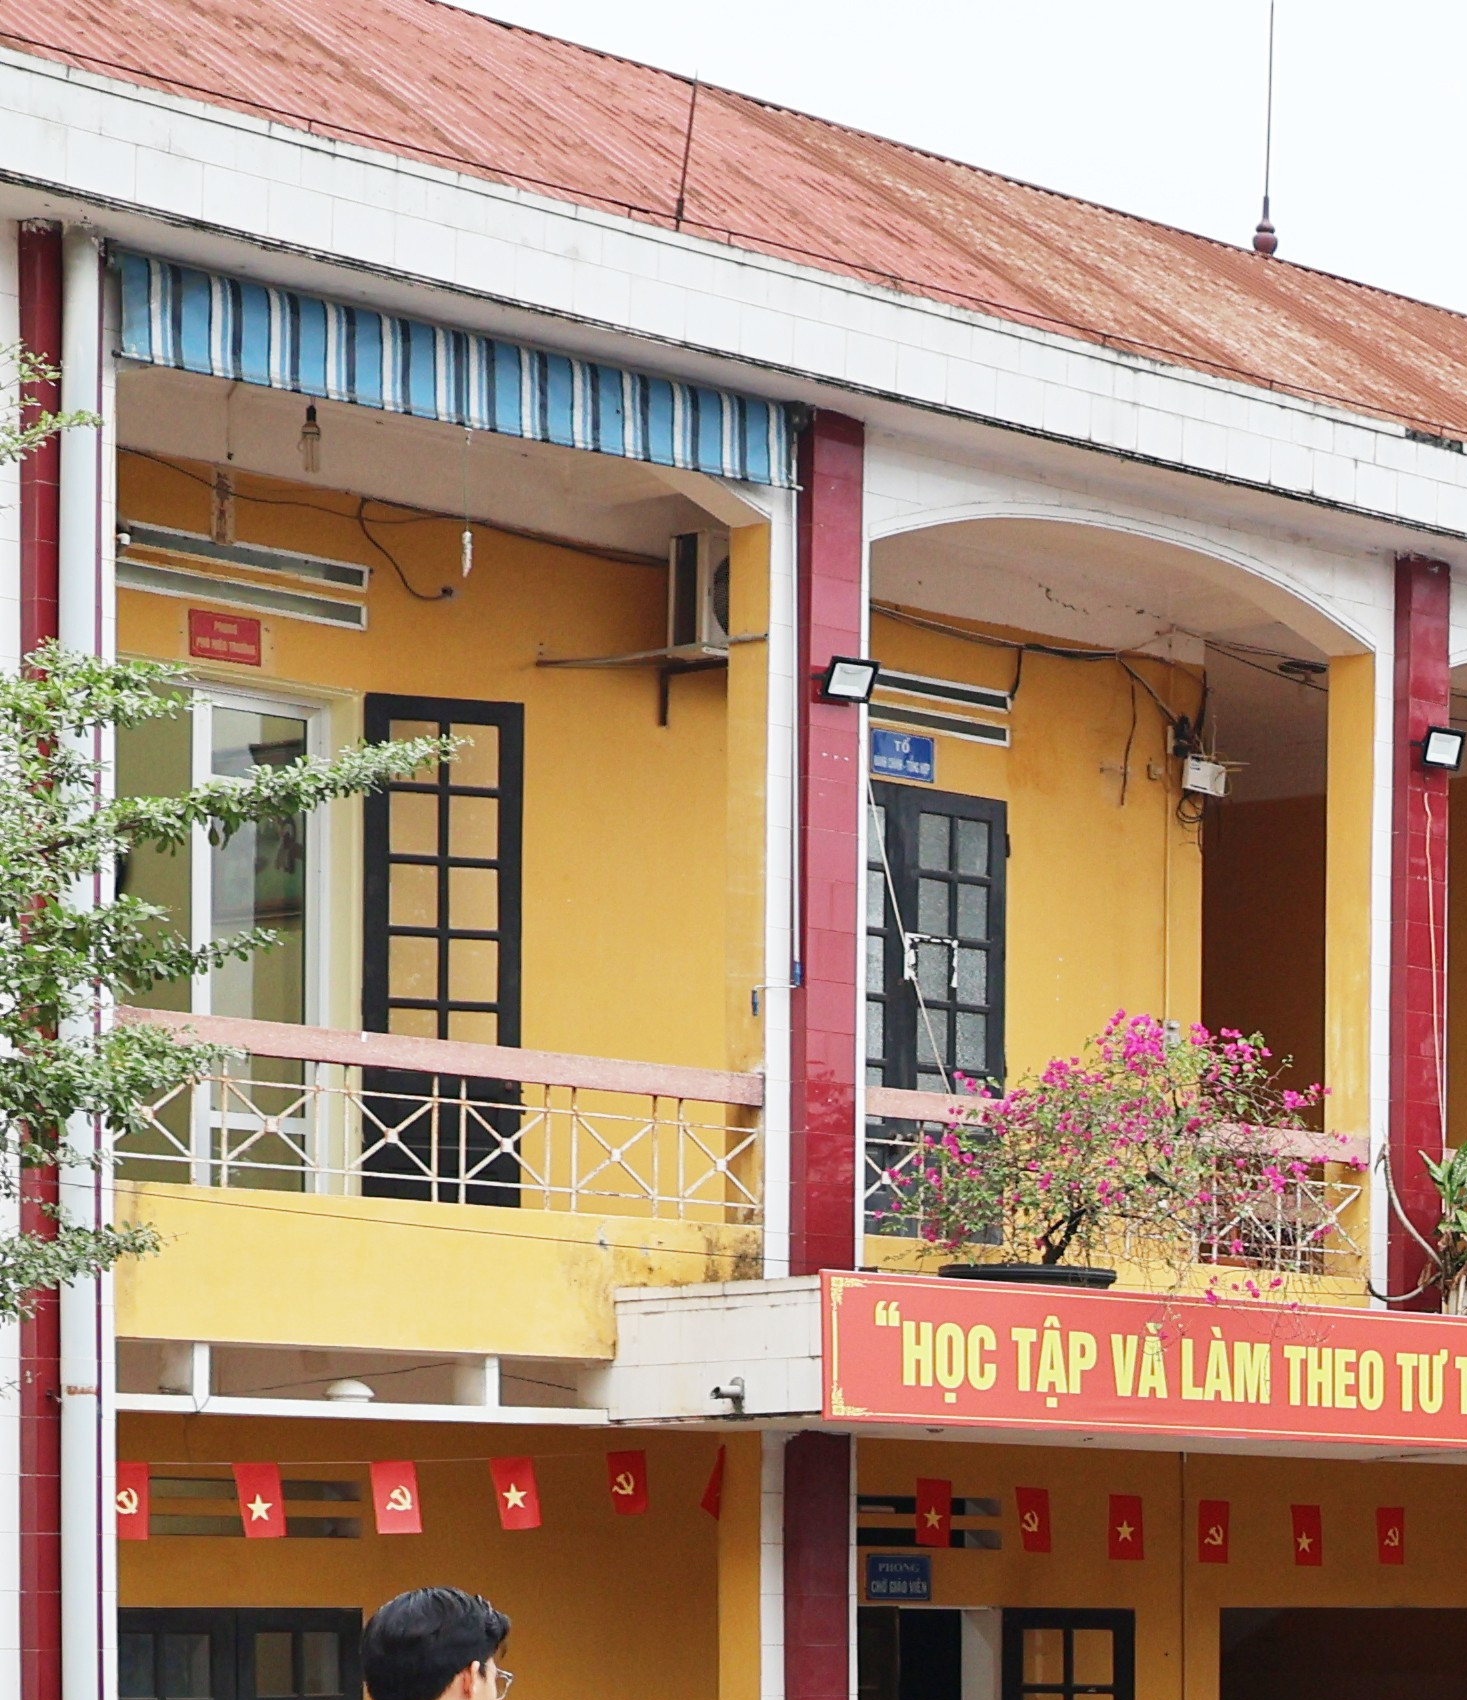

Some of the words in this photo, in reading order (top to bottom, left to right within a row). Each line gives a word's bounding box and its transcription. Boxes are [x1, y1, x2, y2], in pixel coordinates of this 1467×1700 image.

[894, 736, 911, 754] TỔ
[1010, 1315, 1098, 1408] TẬP
[1111, 1322, 1168, 1399] VÀ
[1181, 1326, 1271, 1405] LÀM
[1284, 1344, 1384, 1411] THEO
[1396, 1347, 1448, 1415] TƯ
